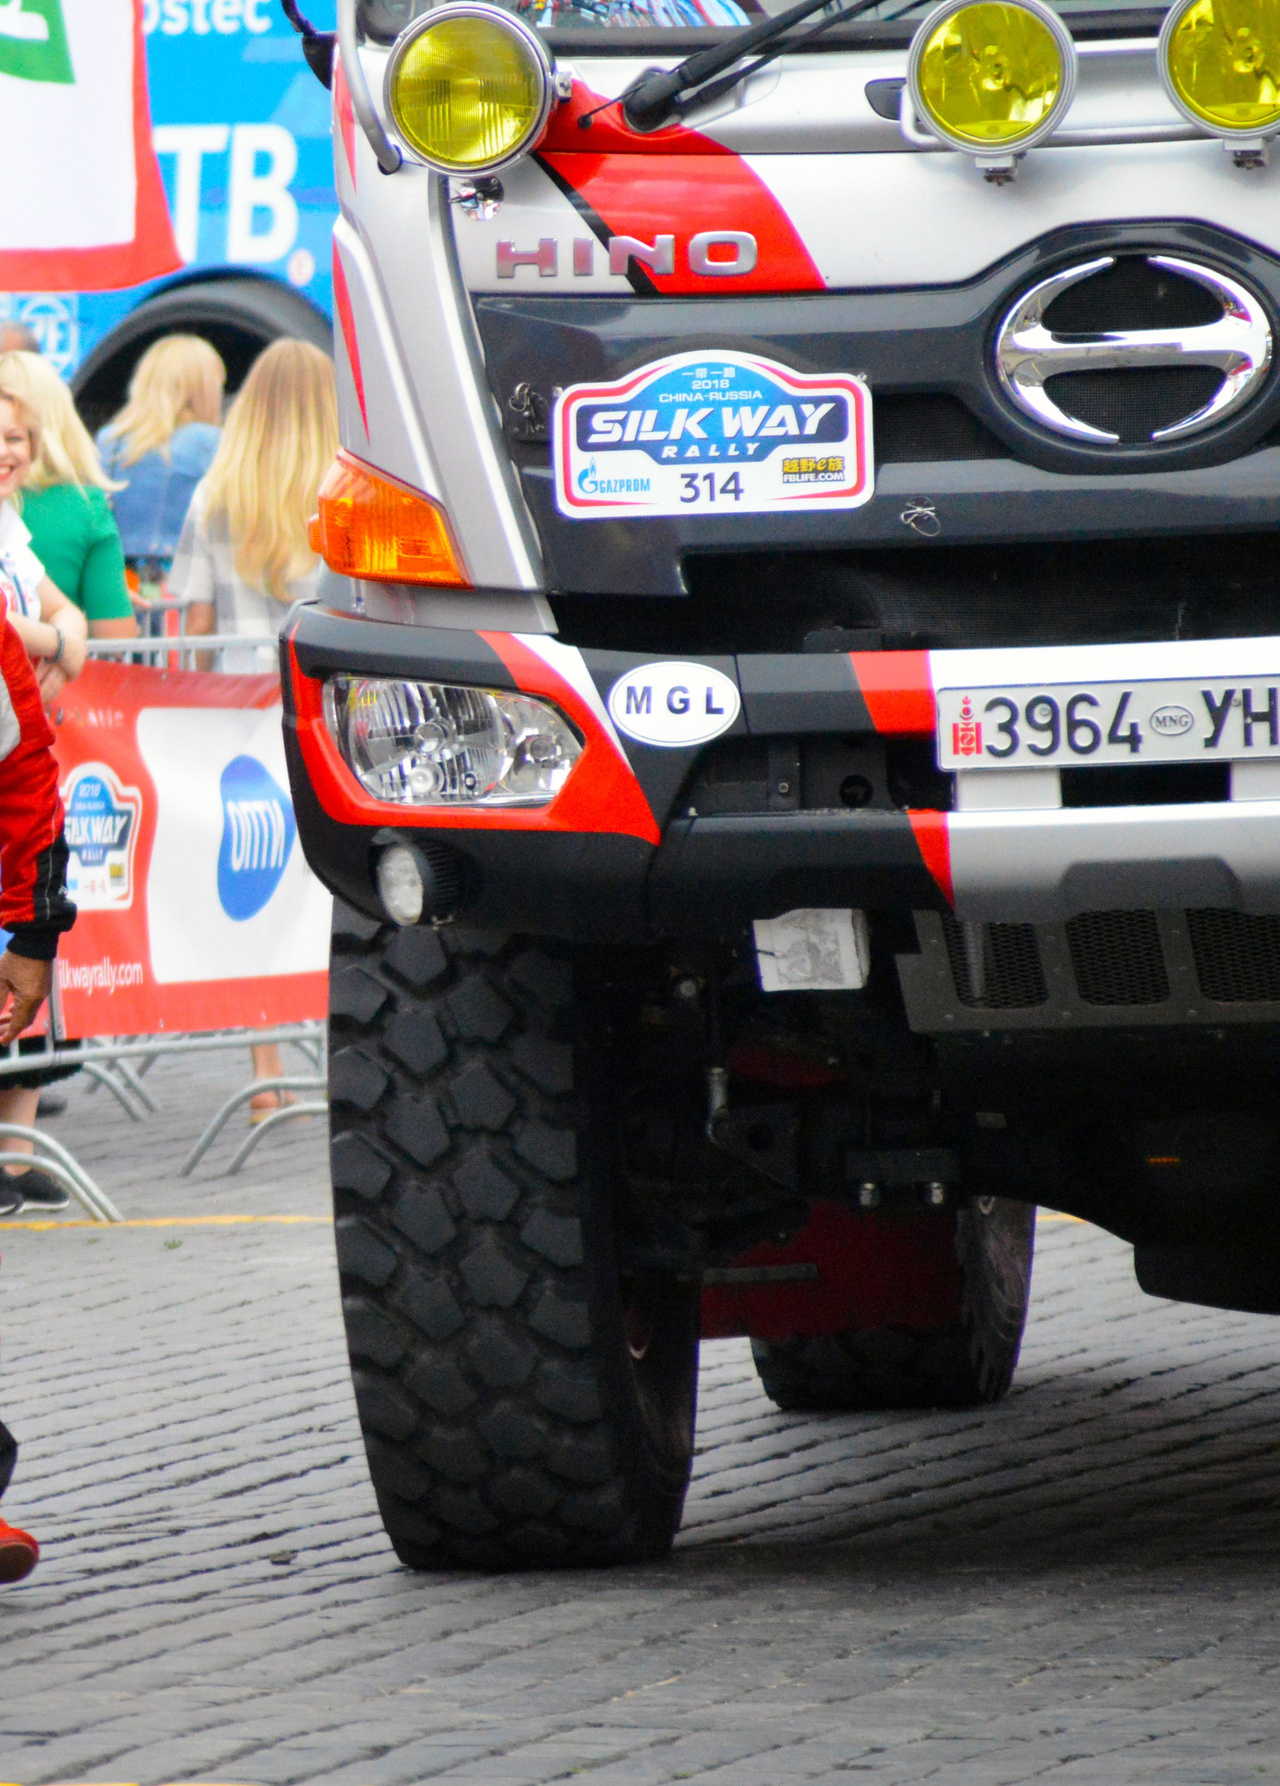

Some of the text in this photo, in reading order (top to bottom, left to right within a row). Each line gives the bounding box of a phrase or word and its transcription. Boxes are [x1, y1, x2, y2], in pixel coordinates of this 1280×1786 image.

[496, 230, 758, 279] HINO
[658, 390, 763, 403] CHINA-RUSSIA
[692, 379, 730, 392] 2018
[587, 403, 837, 444] SILK WAY
[661, 442, 761, 459] RALLY
[599, 477, 651, 494] GAZPROM
[680, 471, 745, 504] 314
[783, 471, 845, 483] FBLIFE.COM
[984, 691, 1143, 759] 3964
[91, 815, 129, 844] WAY
